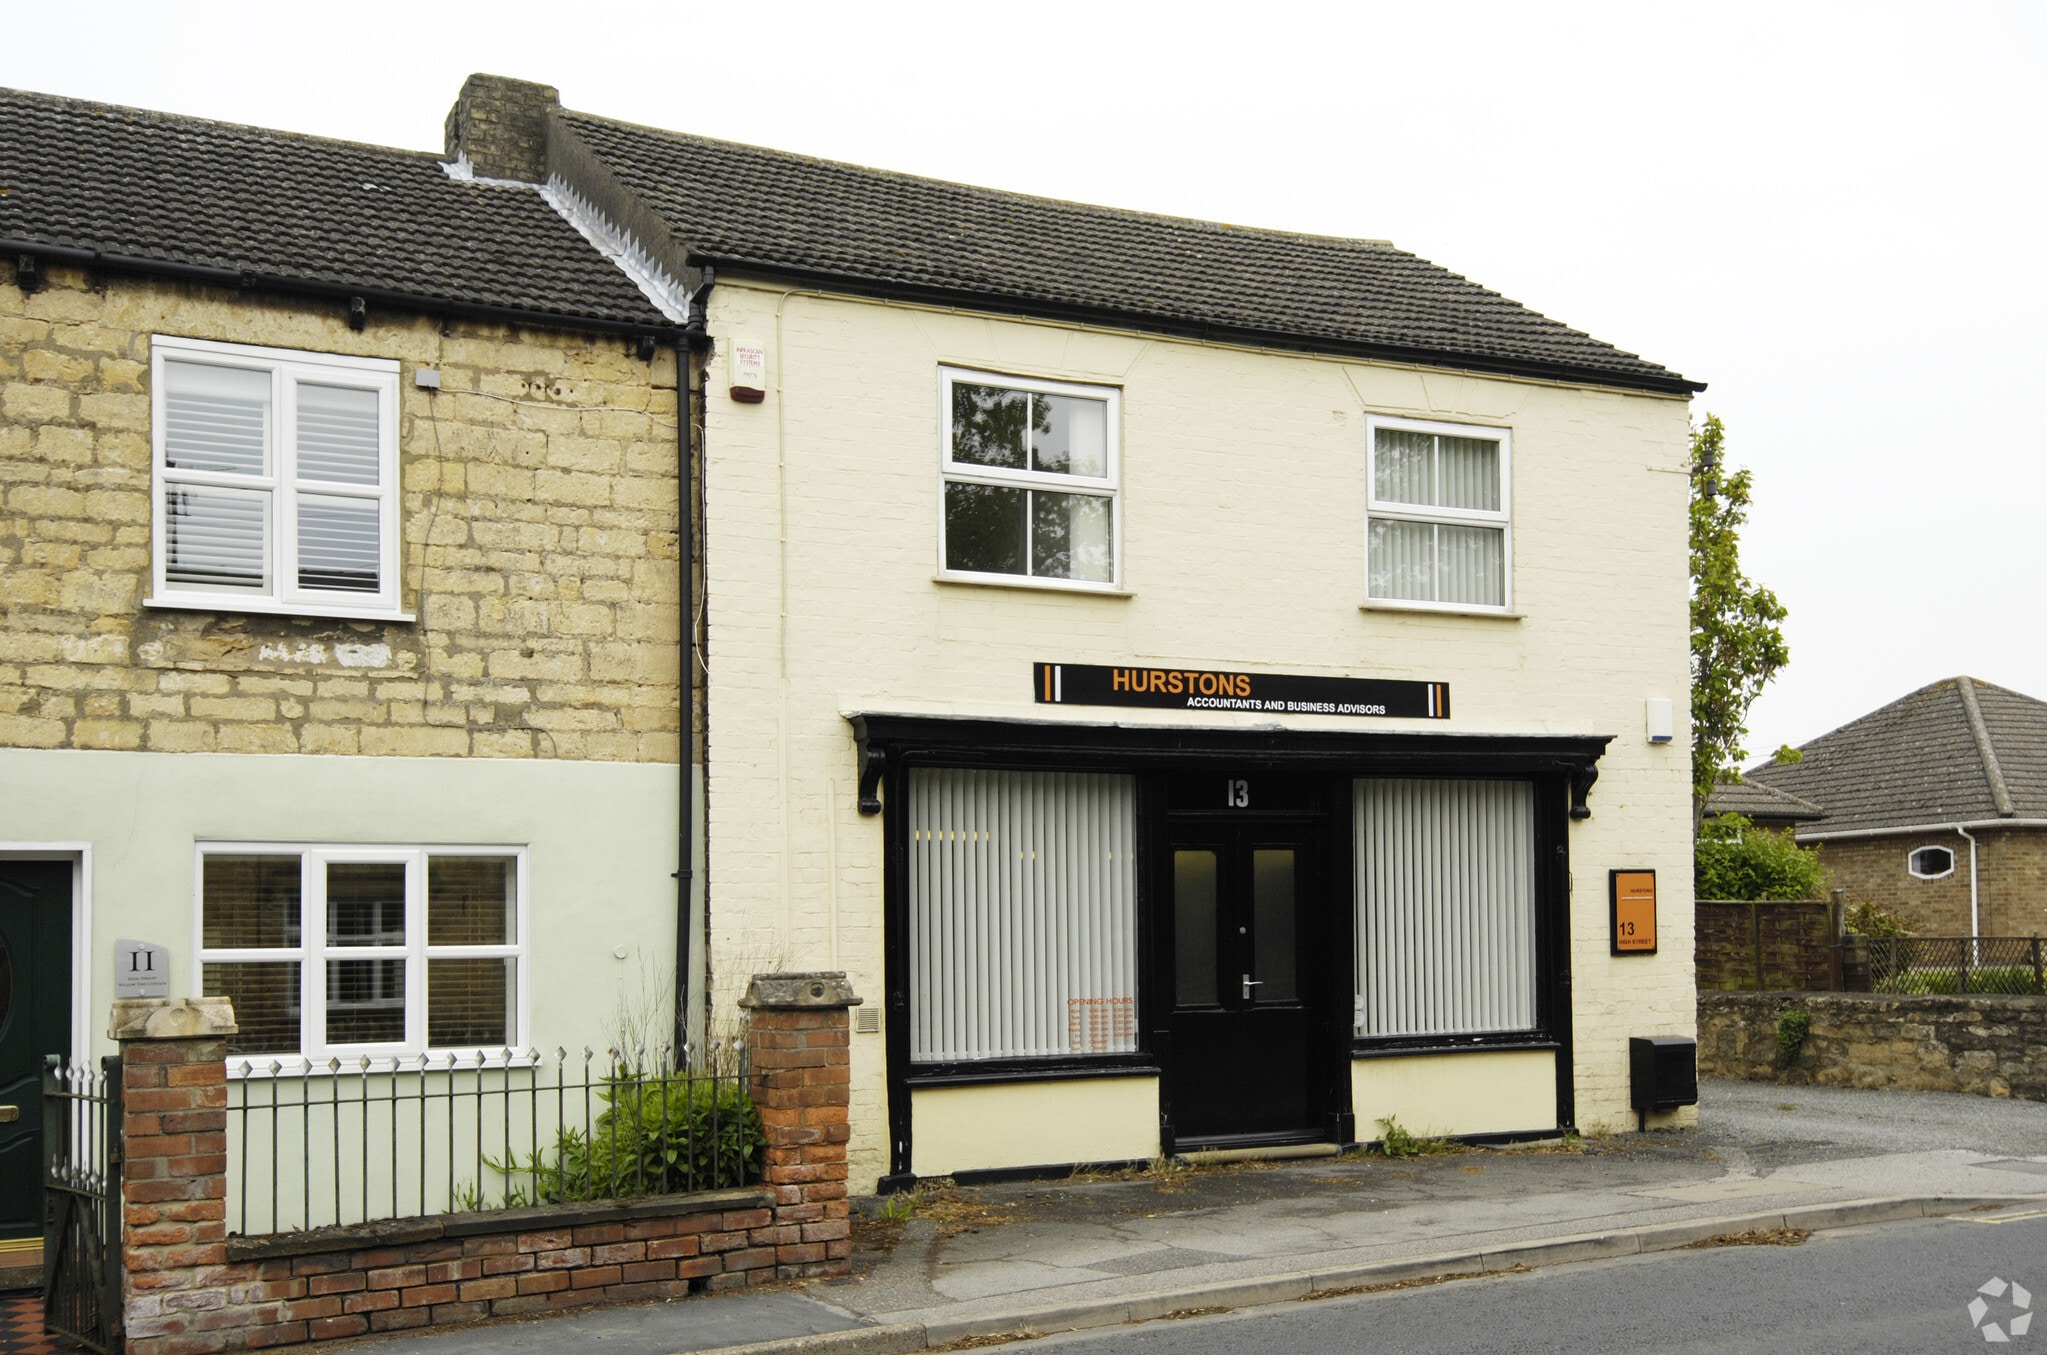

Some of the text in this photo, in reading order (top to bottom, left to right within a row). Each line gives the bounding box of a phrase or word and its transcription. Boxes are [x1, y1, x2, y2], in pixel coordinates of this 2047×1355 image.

[739, 359, 760, 367] SYSTEMS
[1113, 668, 1251, 697] HURSTONS
[1187, 697, 1386, 715] ACCOUNTANTS AND BUSINESS ADVISORS
[1228, 779, 1249, 808] 13
[1619, 921, 1635, 936] 13
[1067, 997, 1133, 1006] OPENING HOURS
